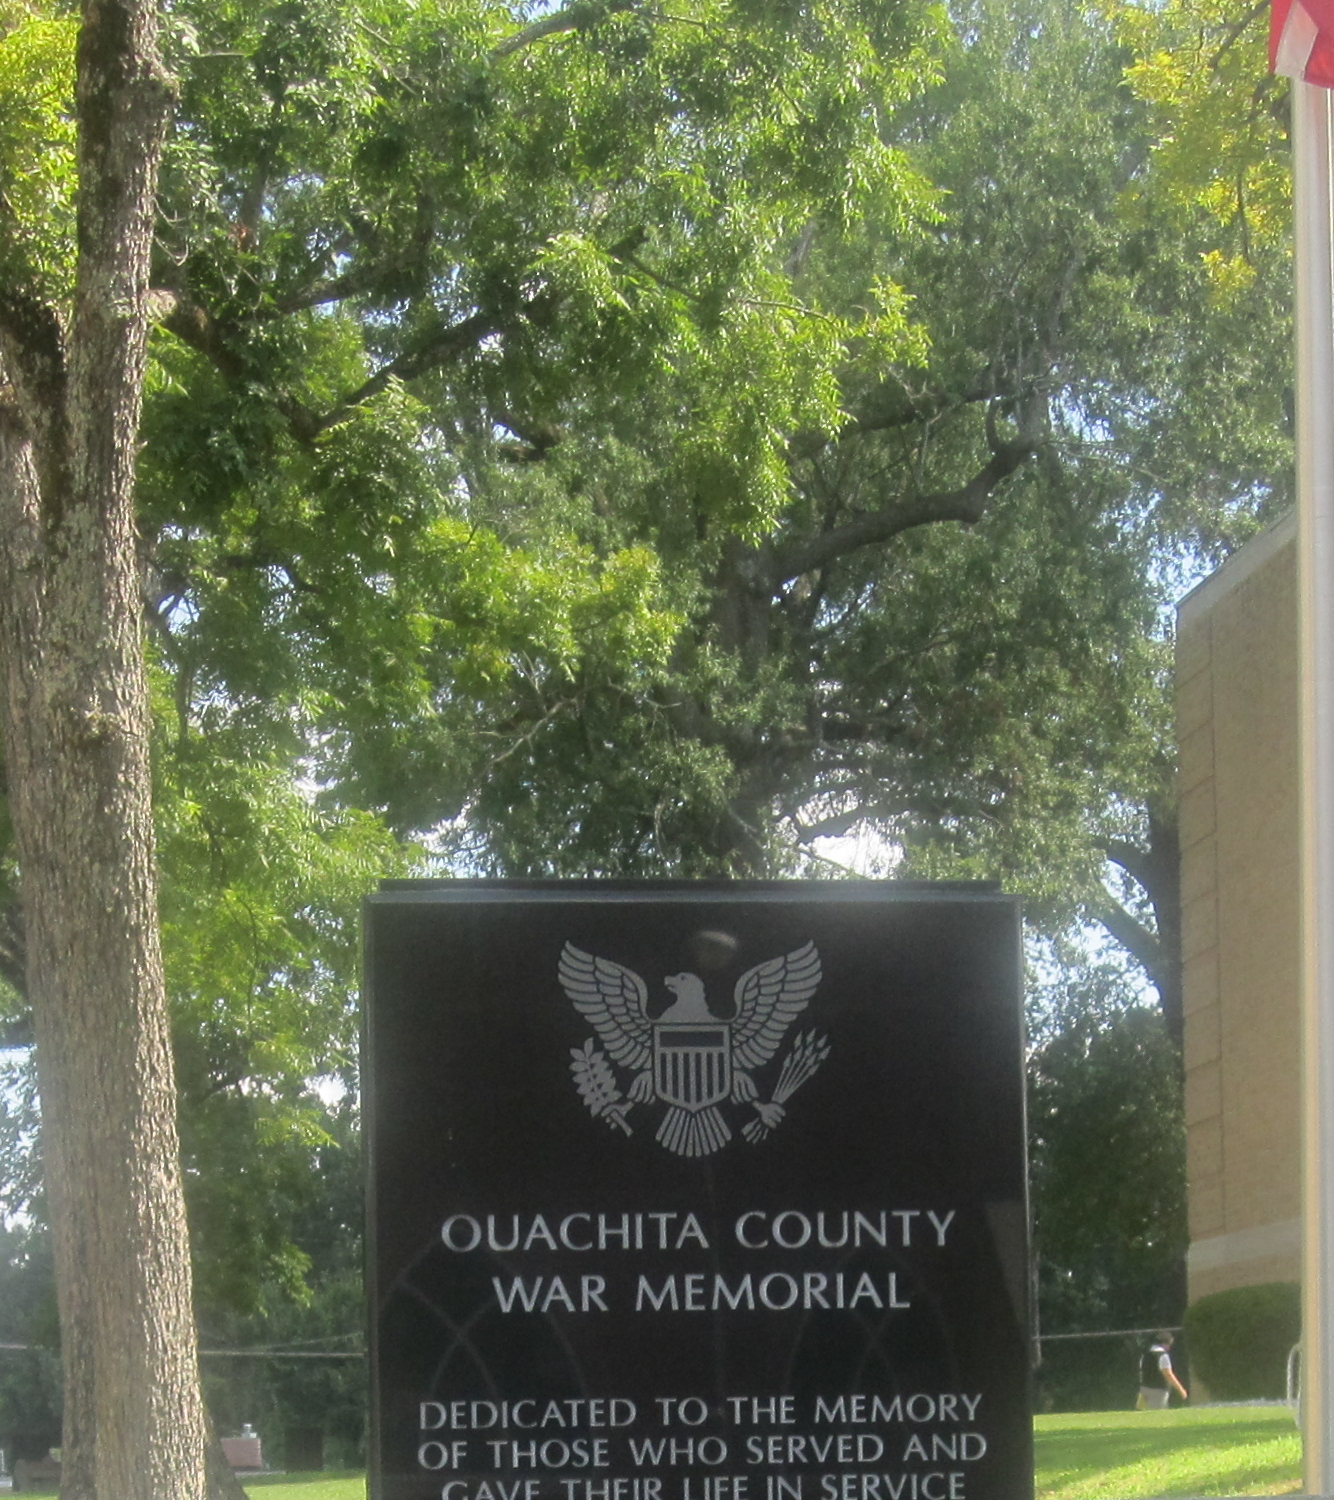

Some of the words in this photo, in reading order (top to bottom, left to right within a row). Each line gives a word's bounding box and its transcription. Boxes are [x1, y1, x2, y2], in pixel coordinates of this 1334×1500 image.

[440, 1211, 710, 1253] OUACHITA
[735, 1209, 956, 1250] COUNTY
[492, 1274, 609, 1313] WAR
[635, 1271, 911, 1311] MEMORIAL
[419, 1399, 637, 1430] DEDICATED
[655, 1398, 708, 1426] TO
[727, 1397, 796, 1425] THE
[814, 1393, 983, 1423] MEMORY
[417, 1441, 469, 1470] OF
[486, 1440, 609, 1468] THOSE
[628, 1438, 728, 1465] WHO
[746, 1434, 884, 1464] SERVED
[903, 1432, 987, 1462] AND
